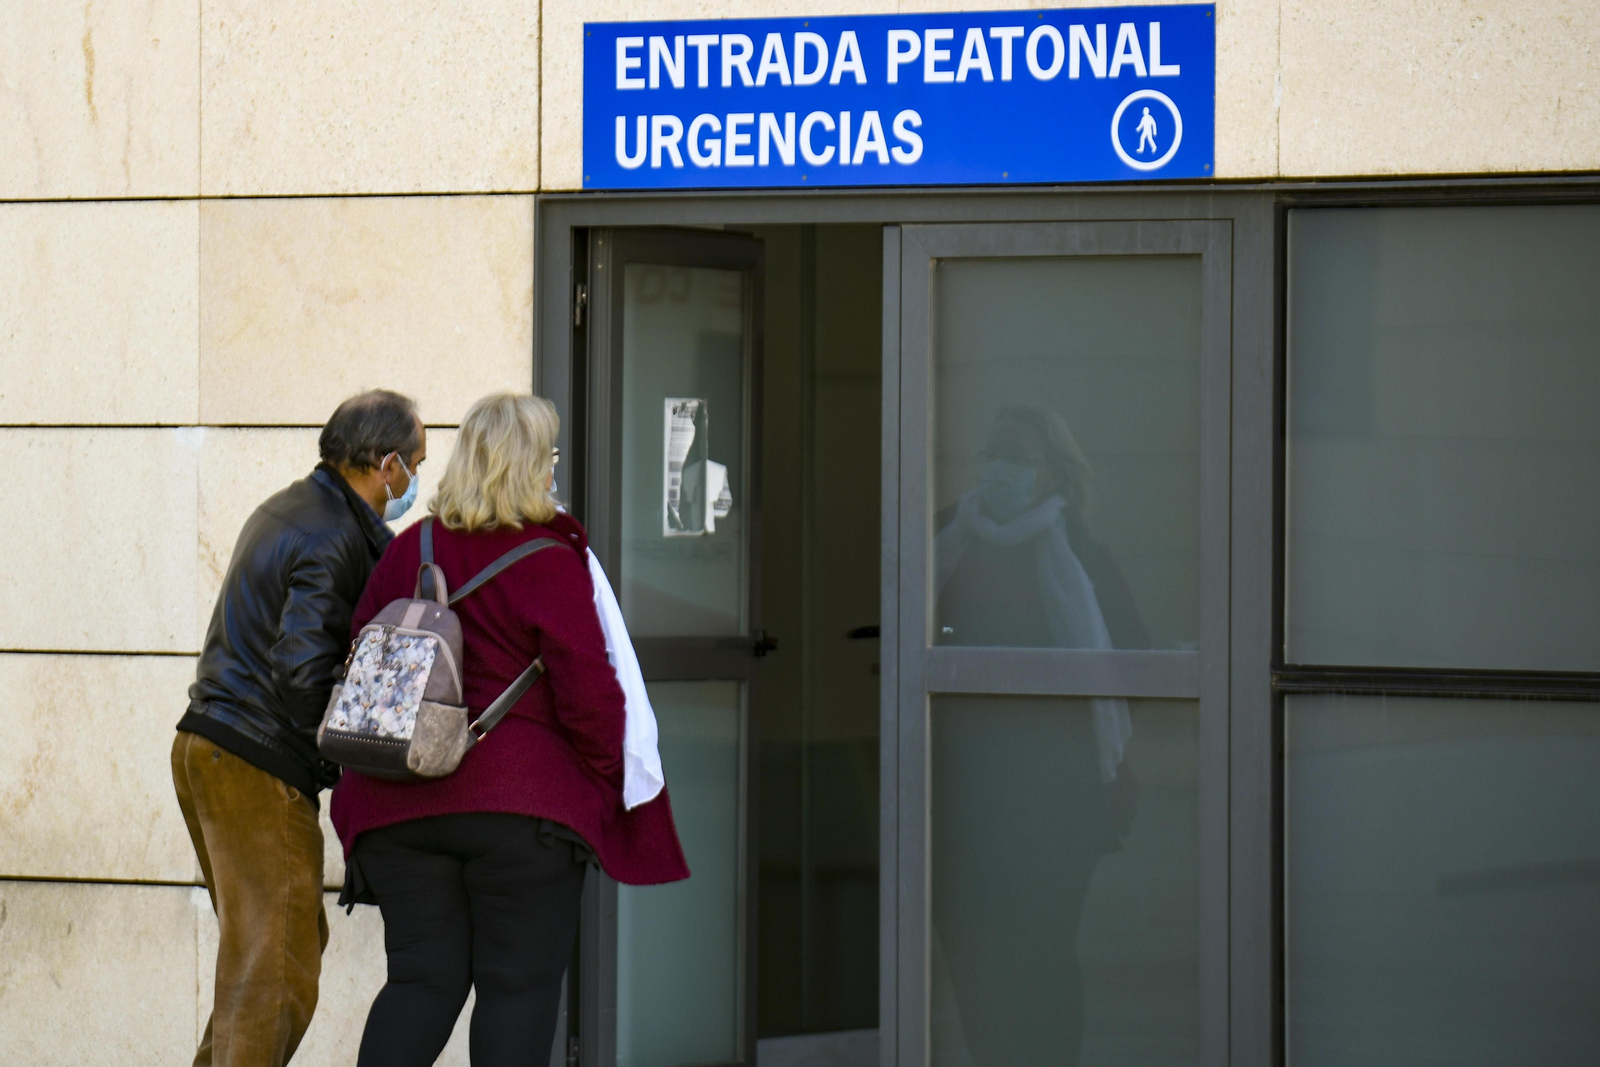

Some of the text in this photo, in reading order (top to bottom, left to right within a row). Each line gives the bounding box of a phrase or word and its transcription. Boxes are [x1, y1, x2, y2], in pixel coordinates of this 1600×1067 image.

[615, 22, 1181, 90] ENTRADA PEATONAL
[615, 109, 924, 170] URGENCIAS
